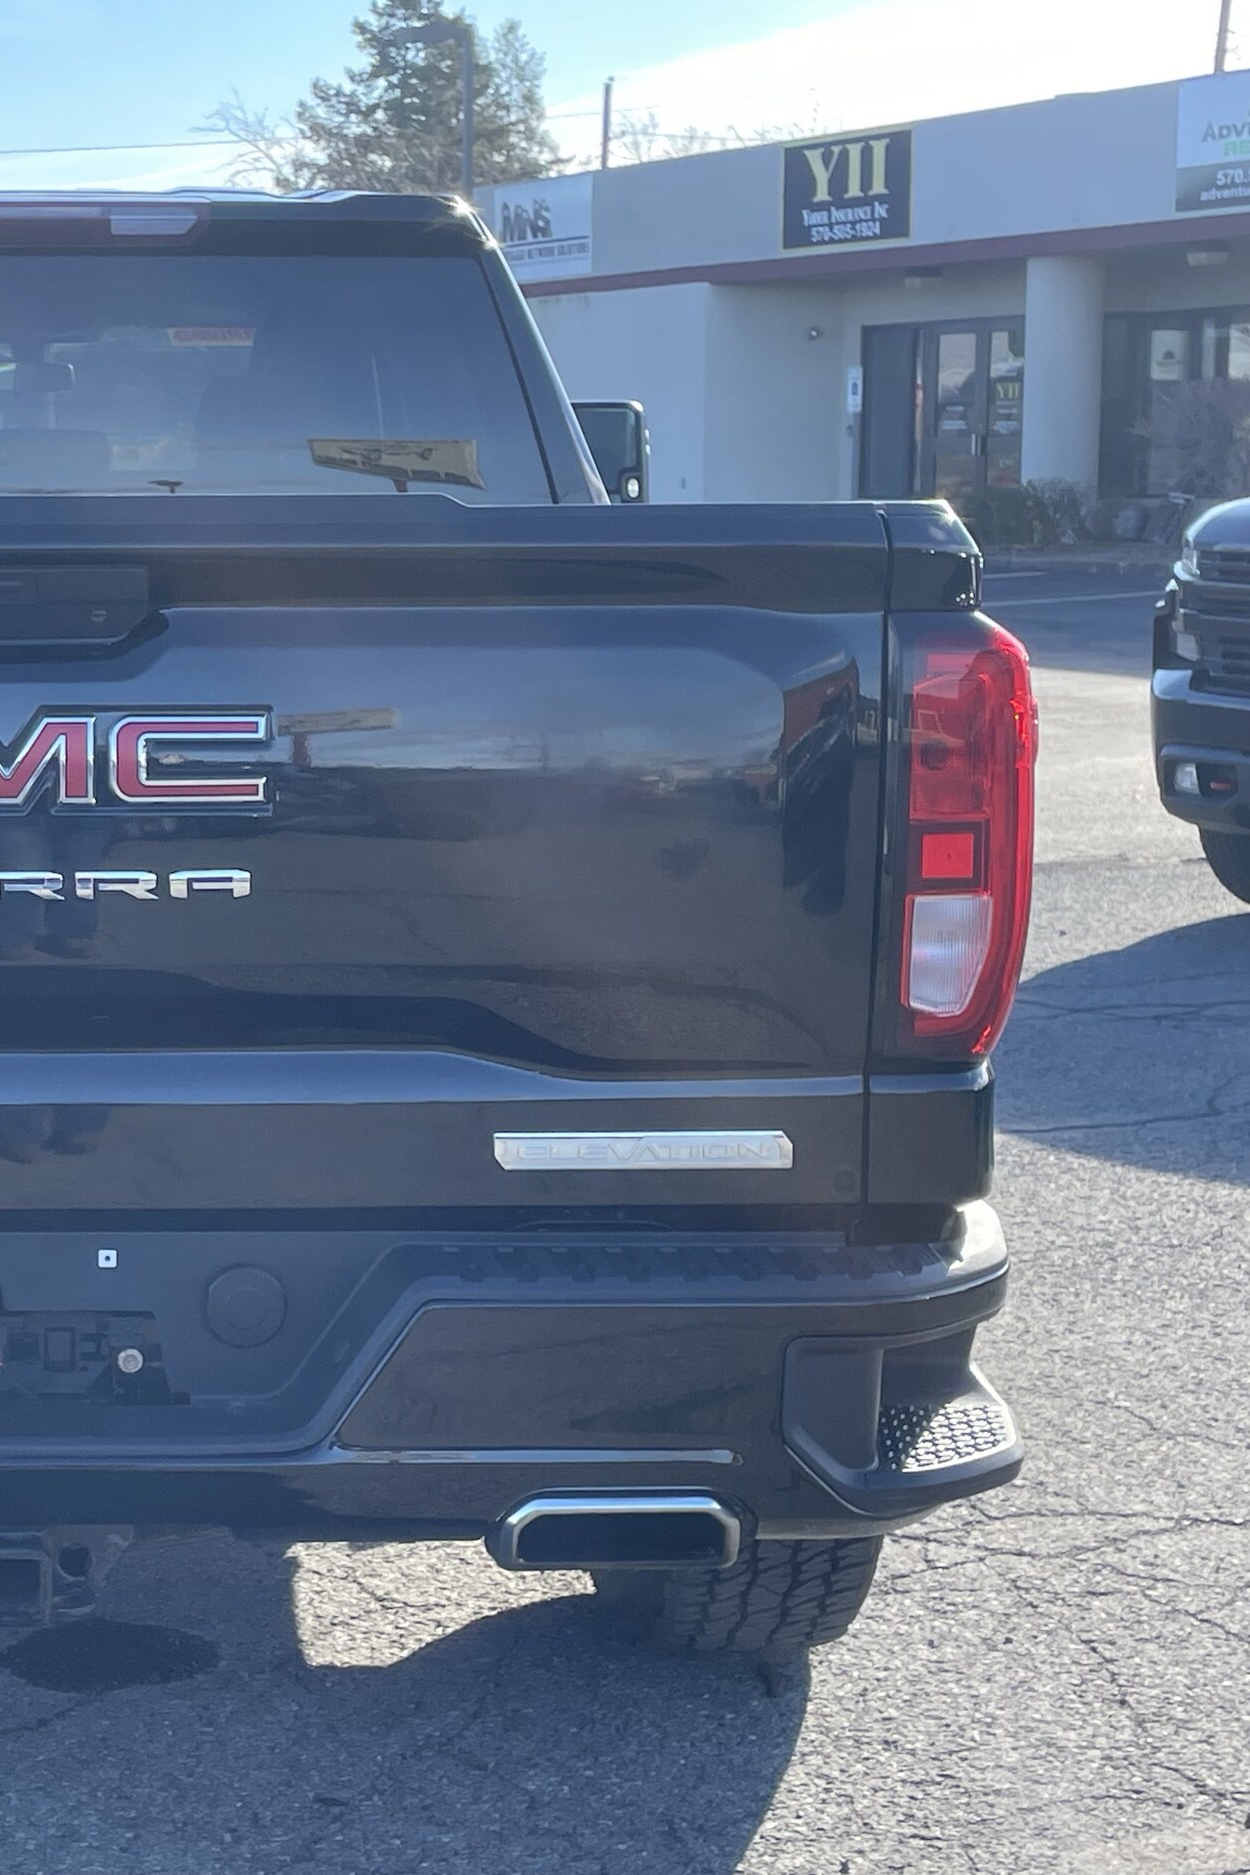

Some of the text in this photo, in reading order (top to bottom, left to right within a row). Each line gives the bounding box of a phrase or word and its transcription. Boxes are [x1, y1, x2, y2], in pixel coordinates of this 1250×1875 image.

[1201, 120, 1250, 143] ADV
[803, 138, 890, 203] YII
[1215, 167, 1250, 186] 570.
[516, 1142, 766, 1162] ELEVATION
